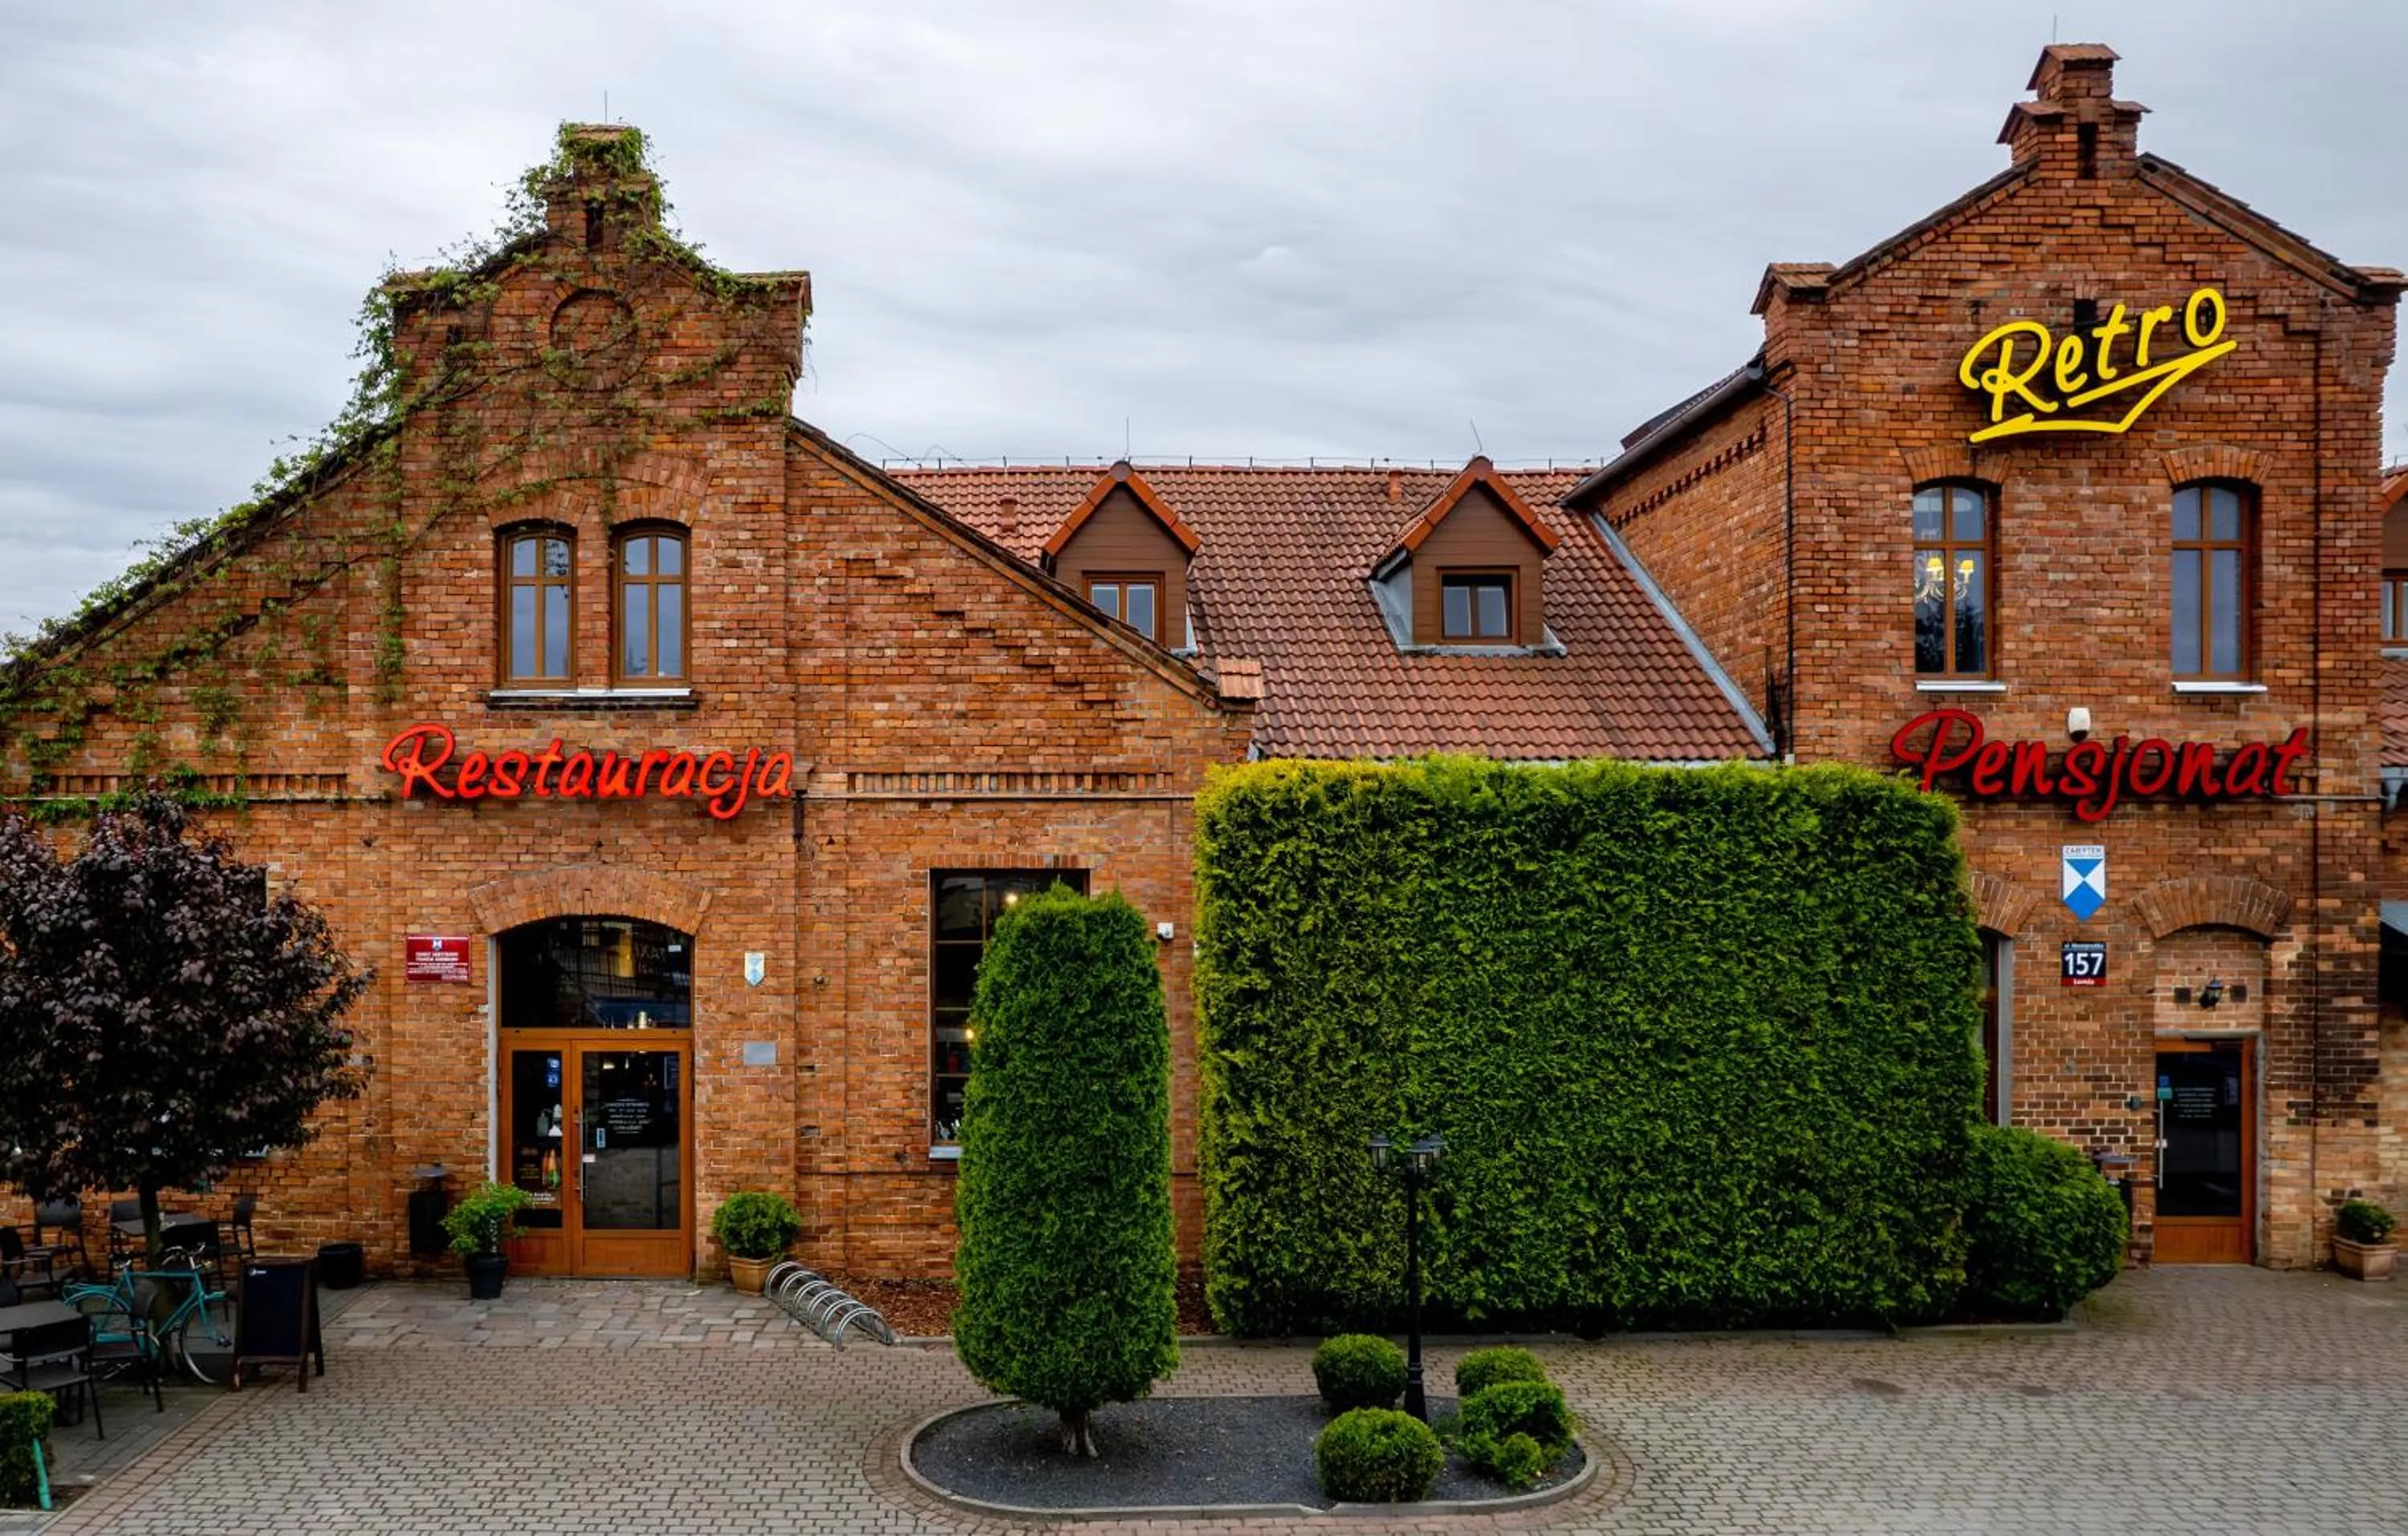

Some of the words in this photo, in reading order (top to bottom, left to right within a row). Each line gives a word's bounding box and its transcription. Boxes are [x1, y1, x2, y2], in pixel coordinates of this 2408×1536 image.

[1959, 287, 2227, 422] Retro
[380, 722, 793, 821] Restauracja
[1889, 708, 2312, 823] Pensjonat
[2064, 953, 2104, 976] 157
